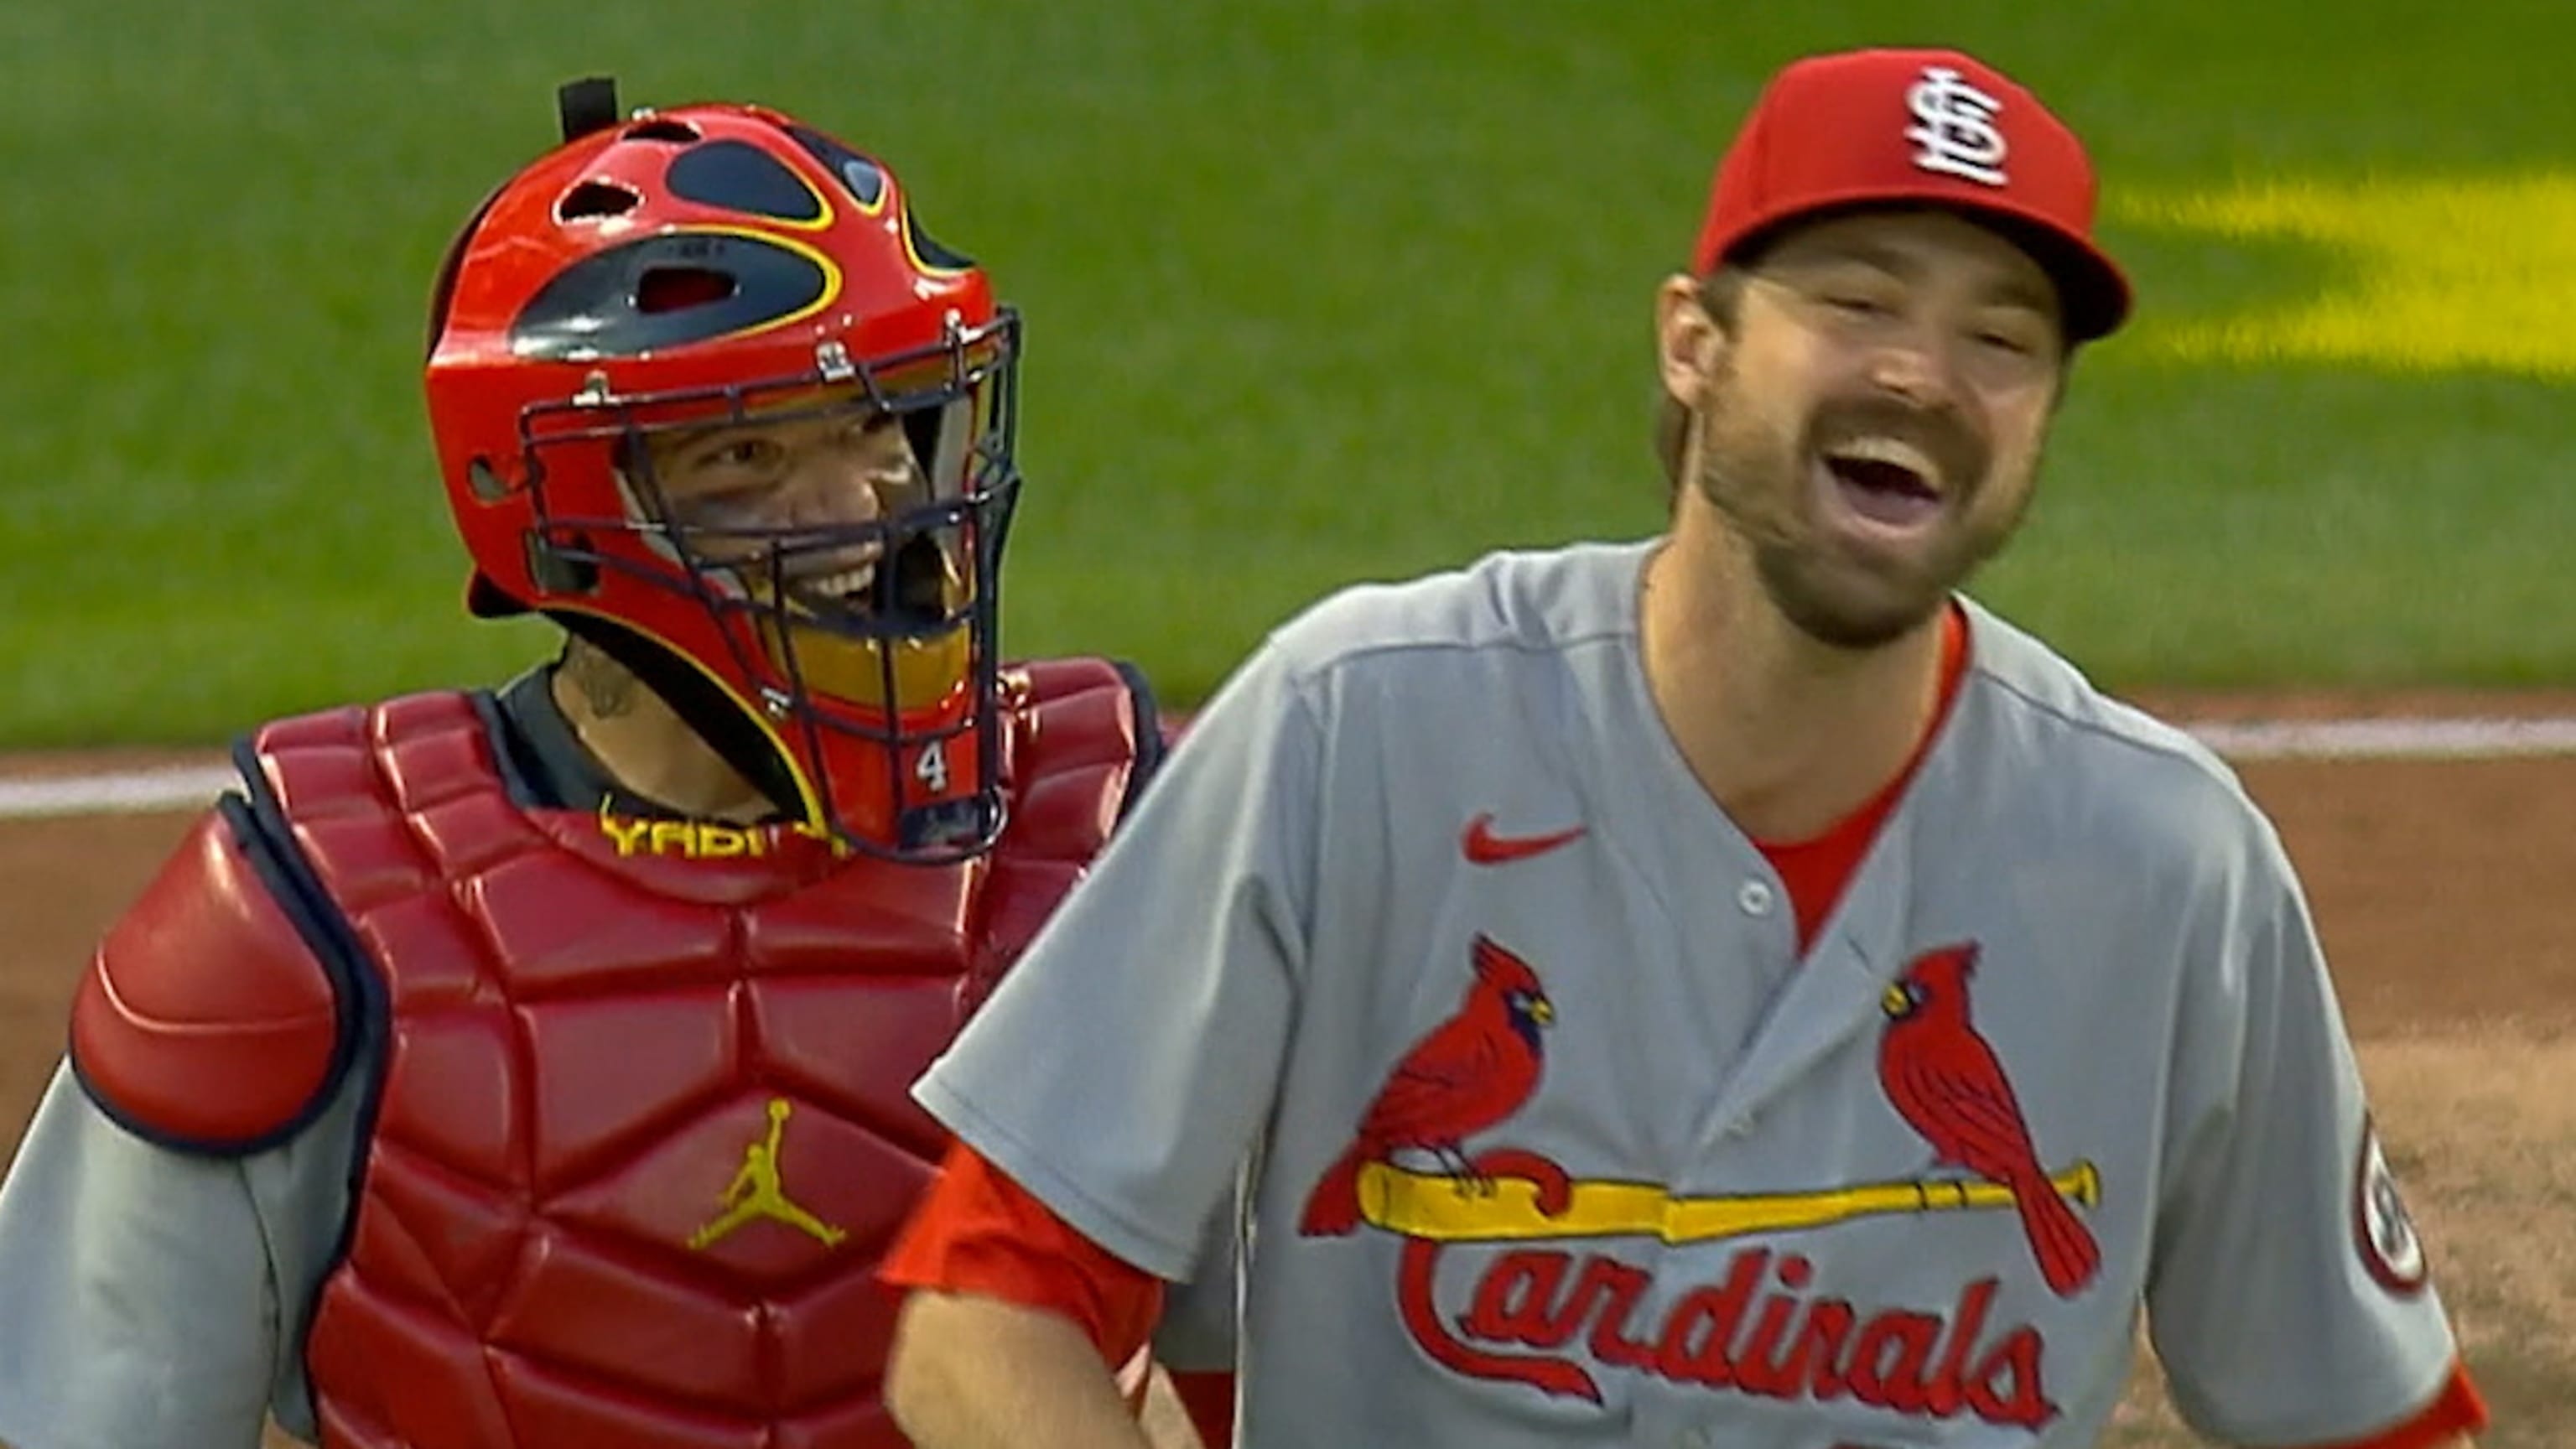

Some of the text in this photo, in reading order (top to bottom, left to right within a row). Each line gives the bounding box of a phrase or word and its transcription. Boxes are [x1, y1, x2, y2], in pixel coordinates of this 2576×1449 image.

[917, 740, 946, 792] 4
[600, 793, 764, 857] YADI
[1397, 1147, 2063, 1434] Cardinals
